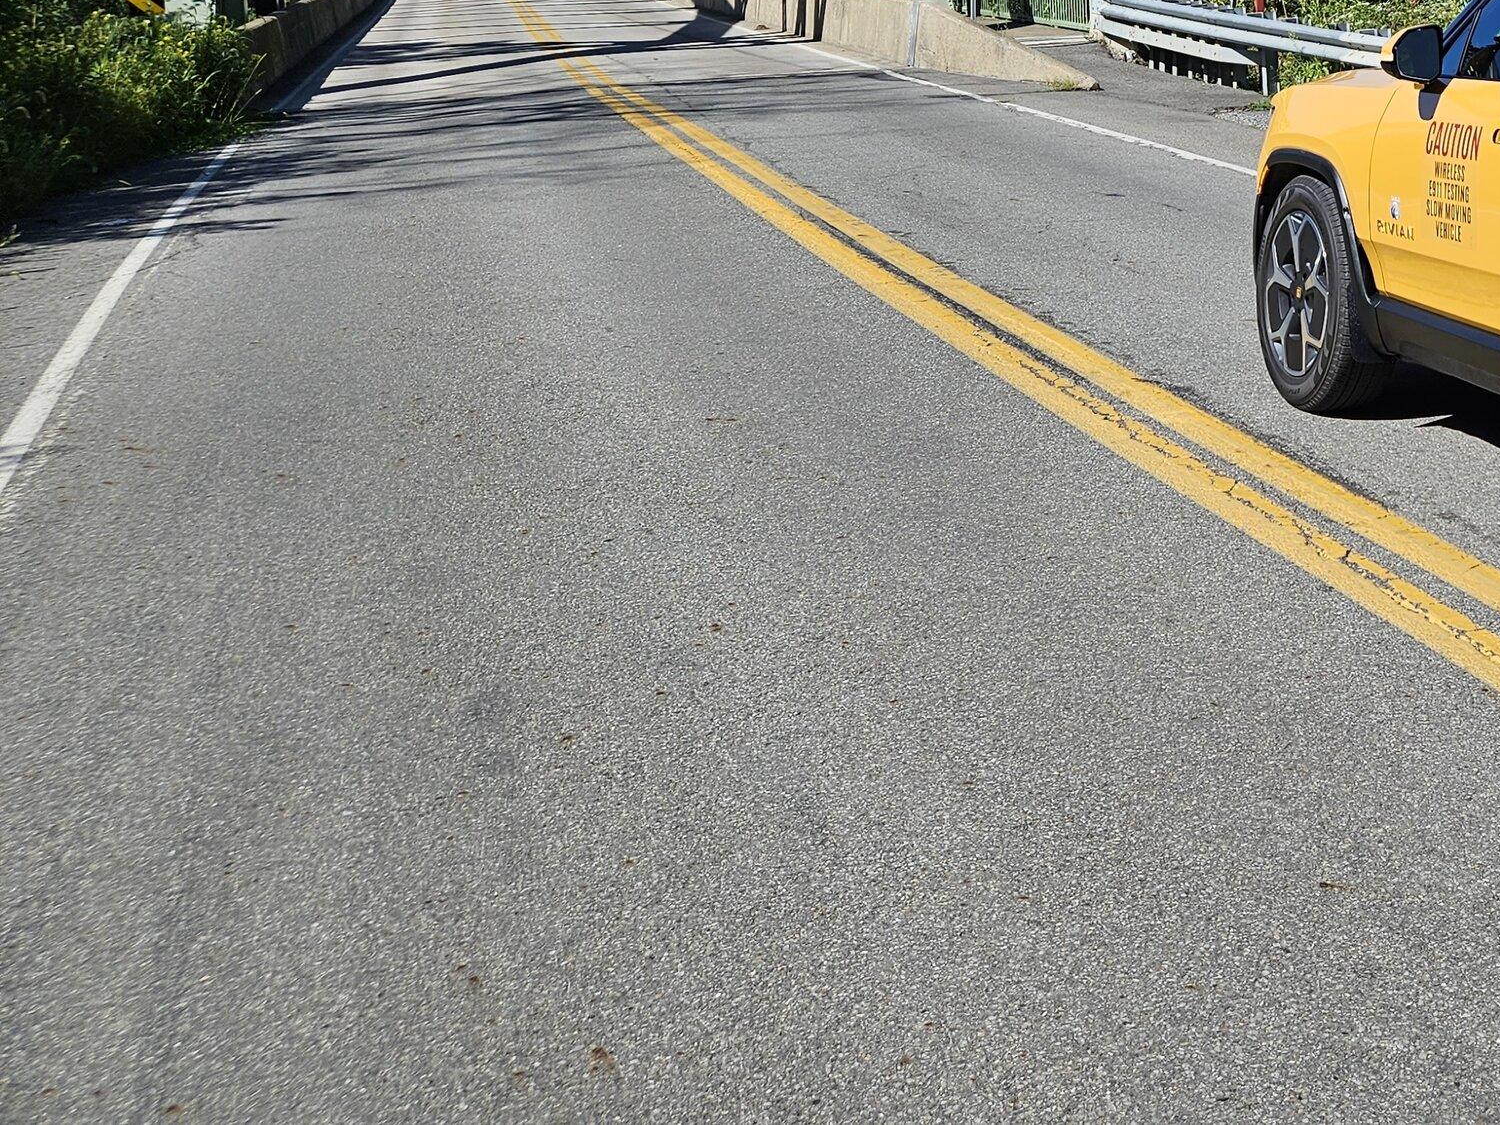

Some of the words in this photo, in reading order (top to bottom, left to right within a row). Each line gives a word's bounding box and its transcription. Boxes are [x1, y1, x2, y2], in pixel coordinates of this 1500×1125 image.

[1426, 121, 1483, 161] CAUTION
[1434, 161, 1466, 182] WIRELESS
[1428, 180, 1443, 197] E911
[1444, 183, 1470, 203] TESTING
[1426, 199, 1444, 219] SLOW
[1445, 203, 1472, 223] MOVING
[1376, 219, 1415, 241] RIVIAN
[1436, 221, 1462, 243] VEHICLE
